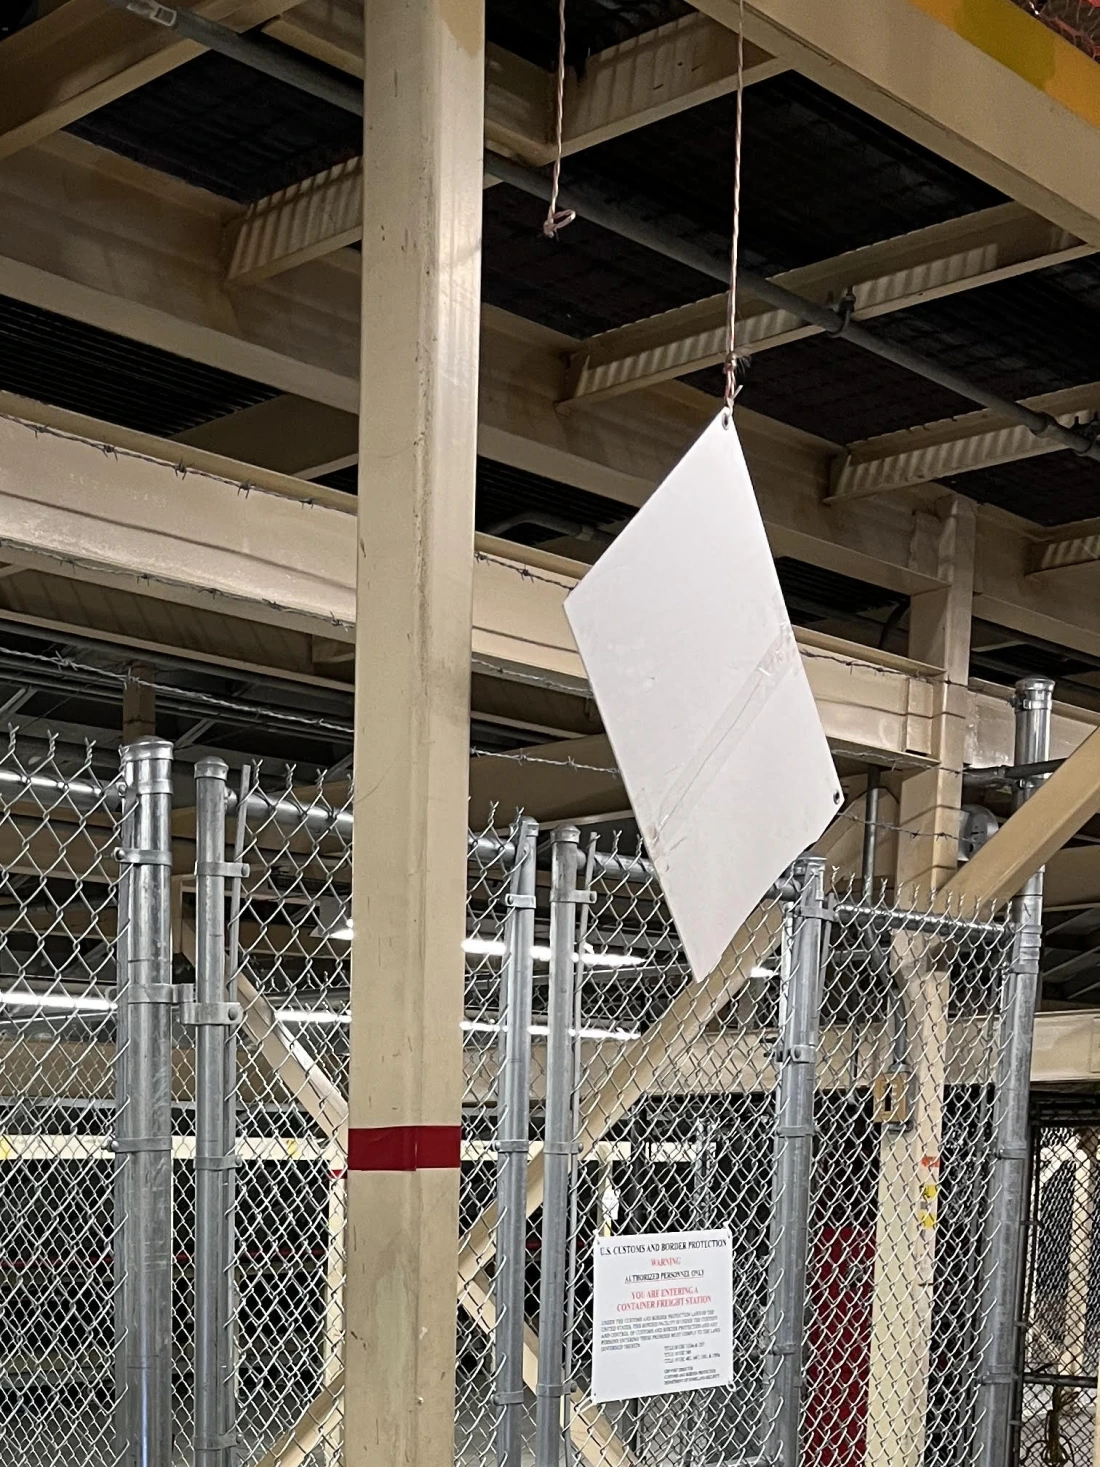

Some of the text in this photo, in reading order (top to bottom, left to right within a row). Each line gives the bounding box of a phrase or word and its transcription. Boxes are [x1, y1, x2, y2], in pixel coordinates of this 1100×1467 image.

[600, 1239, 727, 1256] U.S. CUSTOMS AND BORDER PROTECTION
[651, 1257, 681, 1267] WARNING
[625, 1273, 660, 1282] AUTHORIZED
[661, 1270, 690, 1279] PERSONNEL
[631, 1286, 699, 1300] YOU ARE ENTERING A
[617, 1295, 712, 1312] CONTAINER FREIGHT STATION
